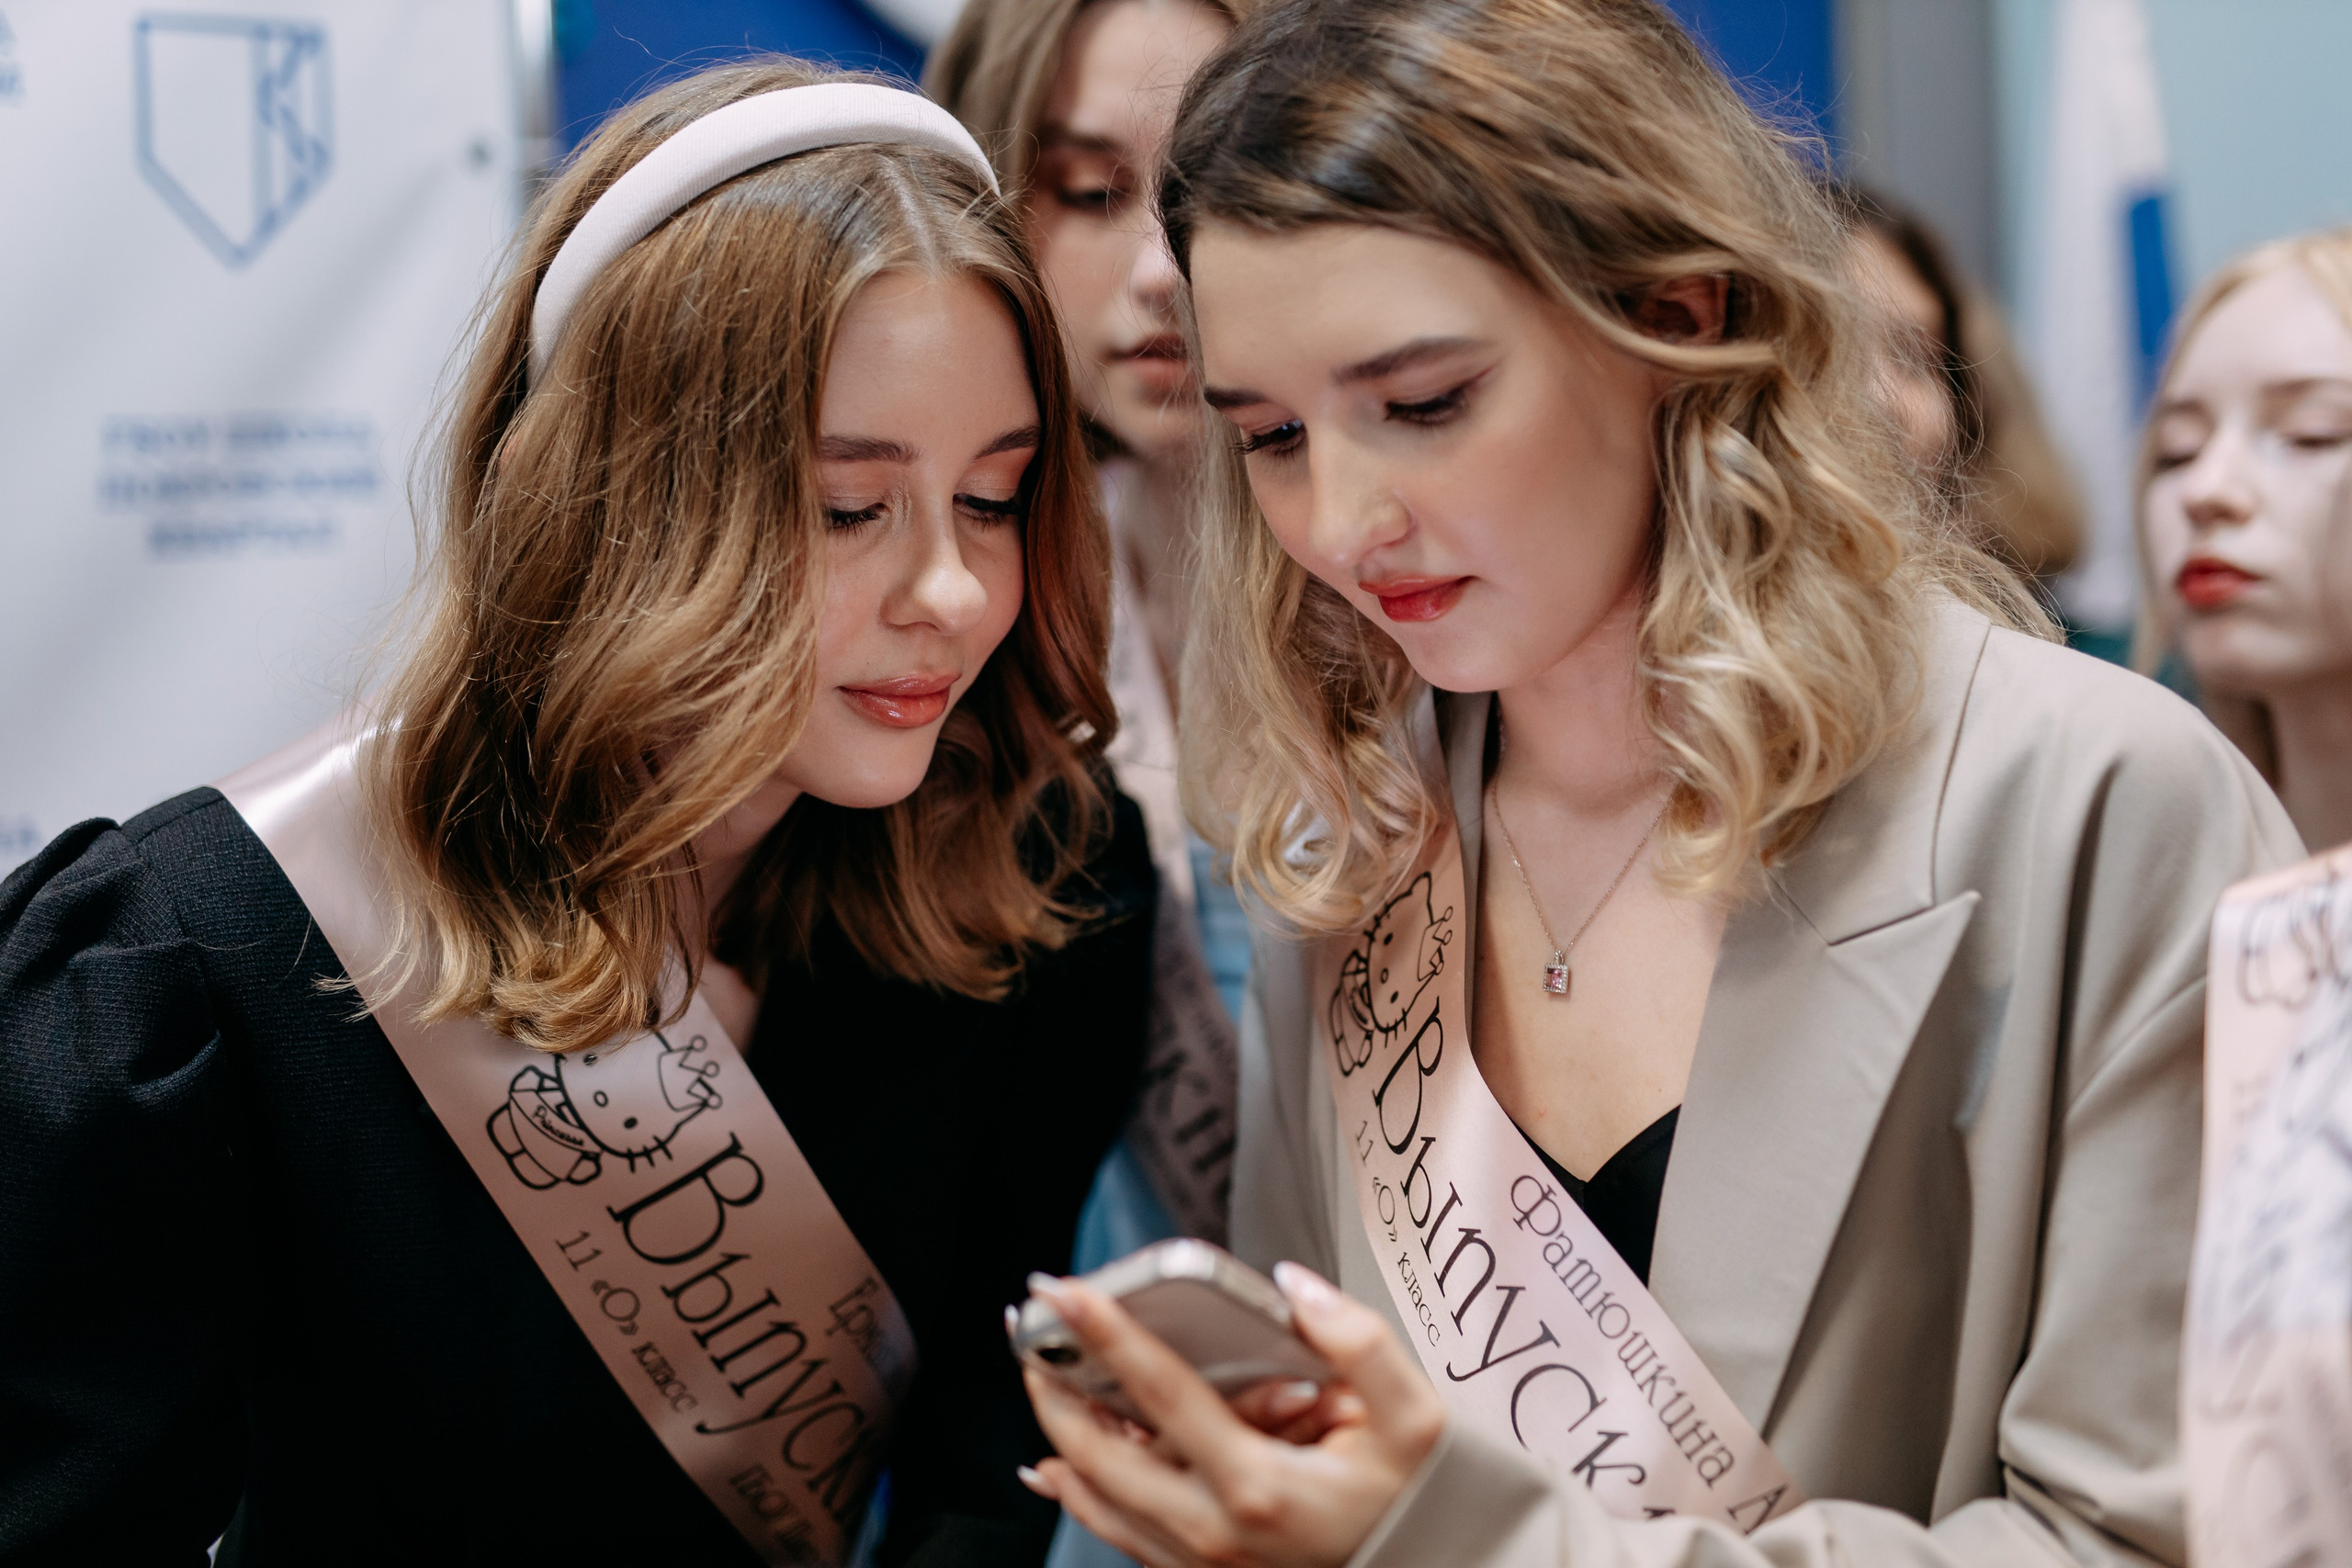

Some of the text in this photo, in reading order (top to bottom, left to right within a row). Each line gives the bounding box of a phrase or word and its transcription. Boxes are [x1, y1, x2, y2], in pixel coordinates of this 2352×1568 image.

[556, 1230, 603, 1271] 11
[632, 1341, 698, 1413] класс
[1353, 1120, 1374, 1165] 11
[1396, 1252, 1442, 1348] класс
[1372, 996, 1676, 1519] Выпуск
[1510, 1173, 1736, 1489] Фатюшкина
